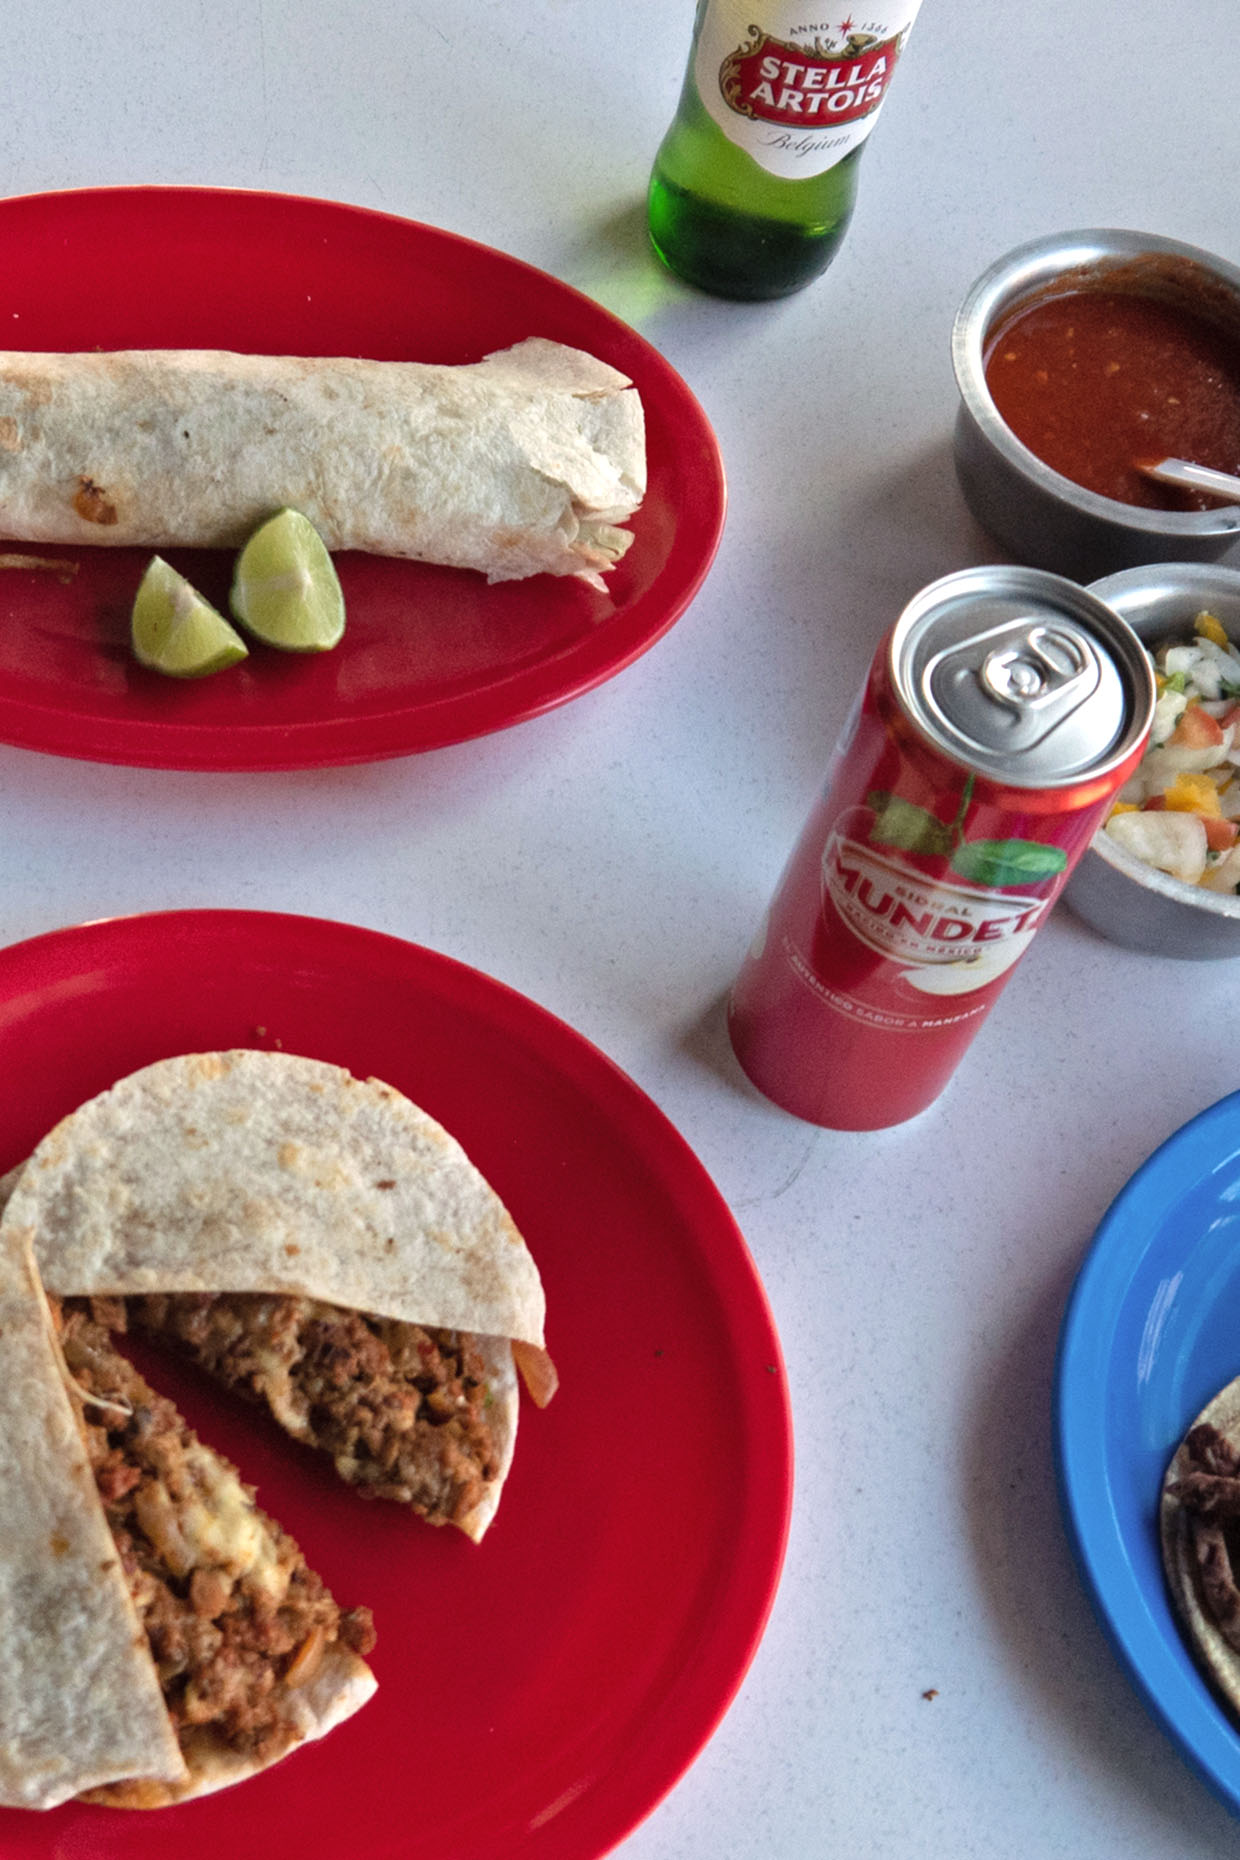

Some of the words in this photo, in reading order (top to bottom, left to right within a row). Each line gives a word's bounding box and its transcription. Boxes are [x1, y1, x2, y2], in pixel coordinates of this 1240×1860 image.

[789, 23, 829, 36] ANNO
[760, 55, 887, 90] STELLA
[749, 77, 882, 114] ARTOIS
[758, 133, 851, 158] Belgium
